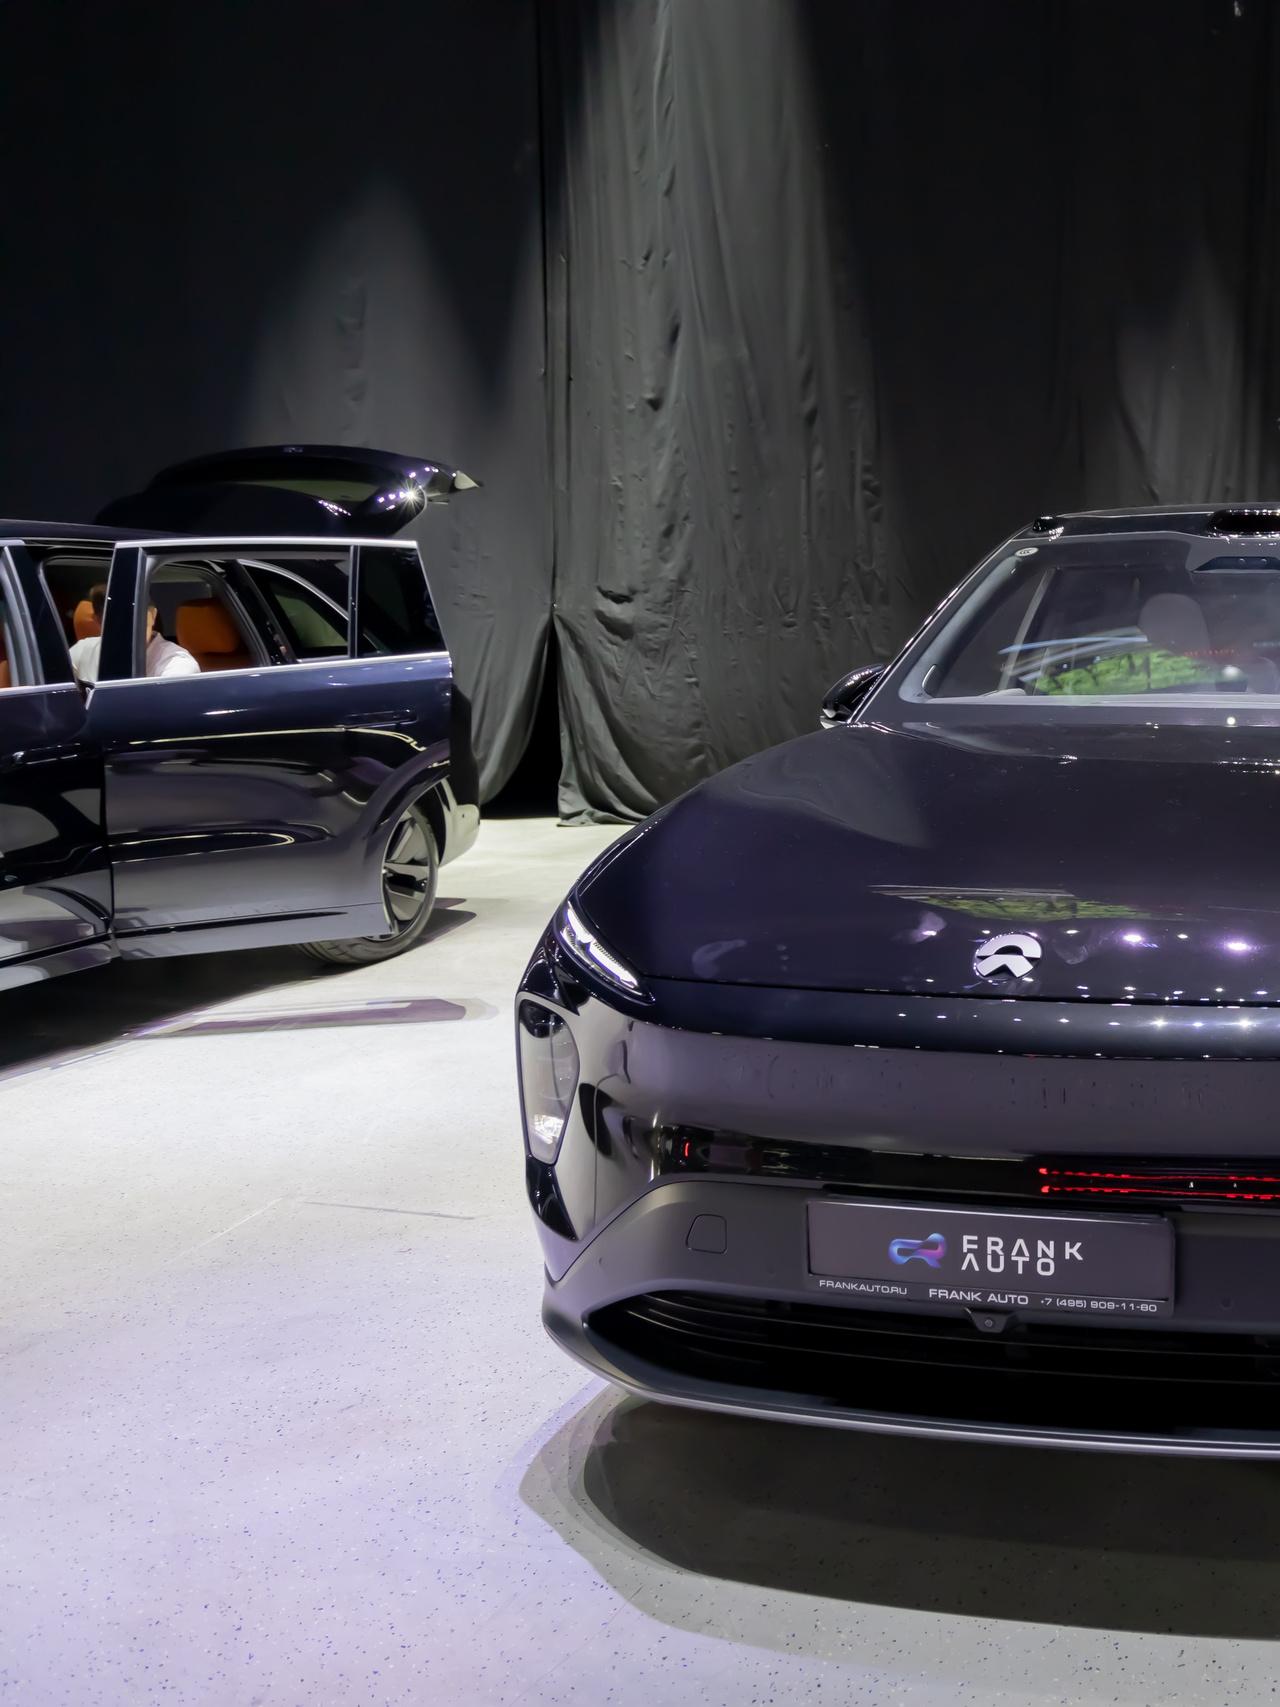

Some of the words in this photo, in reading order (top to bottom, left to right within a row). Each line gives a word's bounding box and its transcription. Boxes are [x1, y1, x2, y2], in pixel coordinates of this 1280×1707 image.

[962, 1234, 1084, 1261] FRANK
[960, 1252, 1055, 1277] AUTO
[928, 1288, 982, 1302] FRANK
[987, 1293, 1029, 1305] AUTO
[1040, 1297, 1053, 1306] +7
[1056, 1298, 1087, 1308] (495)
